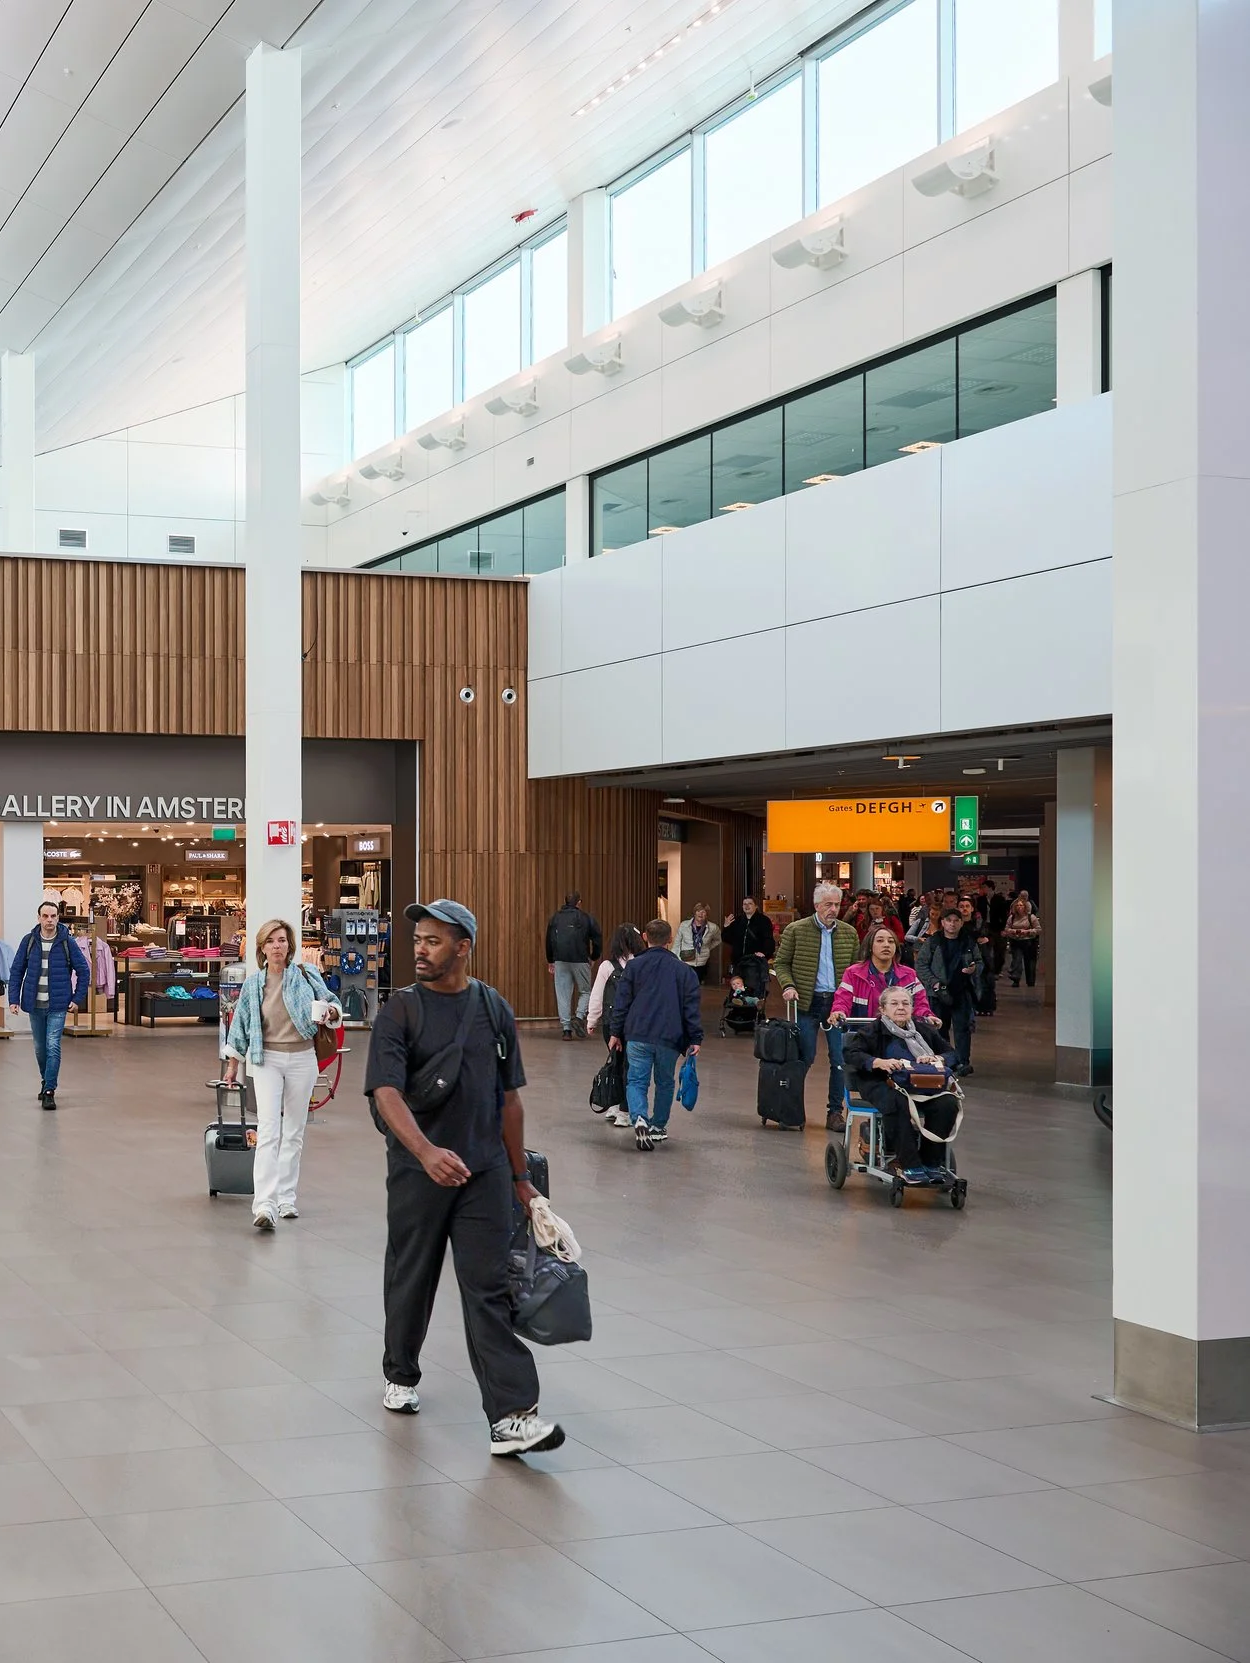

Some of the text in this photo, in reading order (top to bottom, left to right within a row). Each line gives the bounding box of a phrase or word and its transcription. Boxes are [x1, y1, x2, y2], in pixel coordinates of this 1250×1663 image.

[106, 796, 131, 818] IN
[136, 796, 247, 819] AMSTER
[828, 802, 912, 814] Gates DEFGH
[358, 840, 375, 852] BOSS
